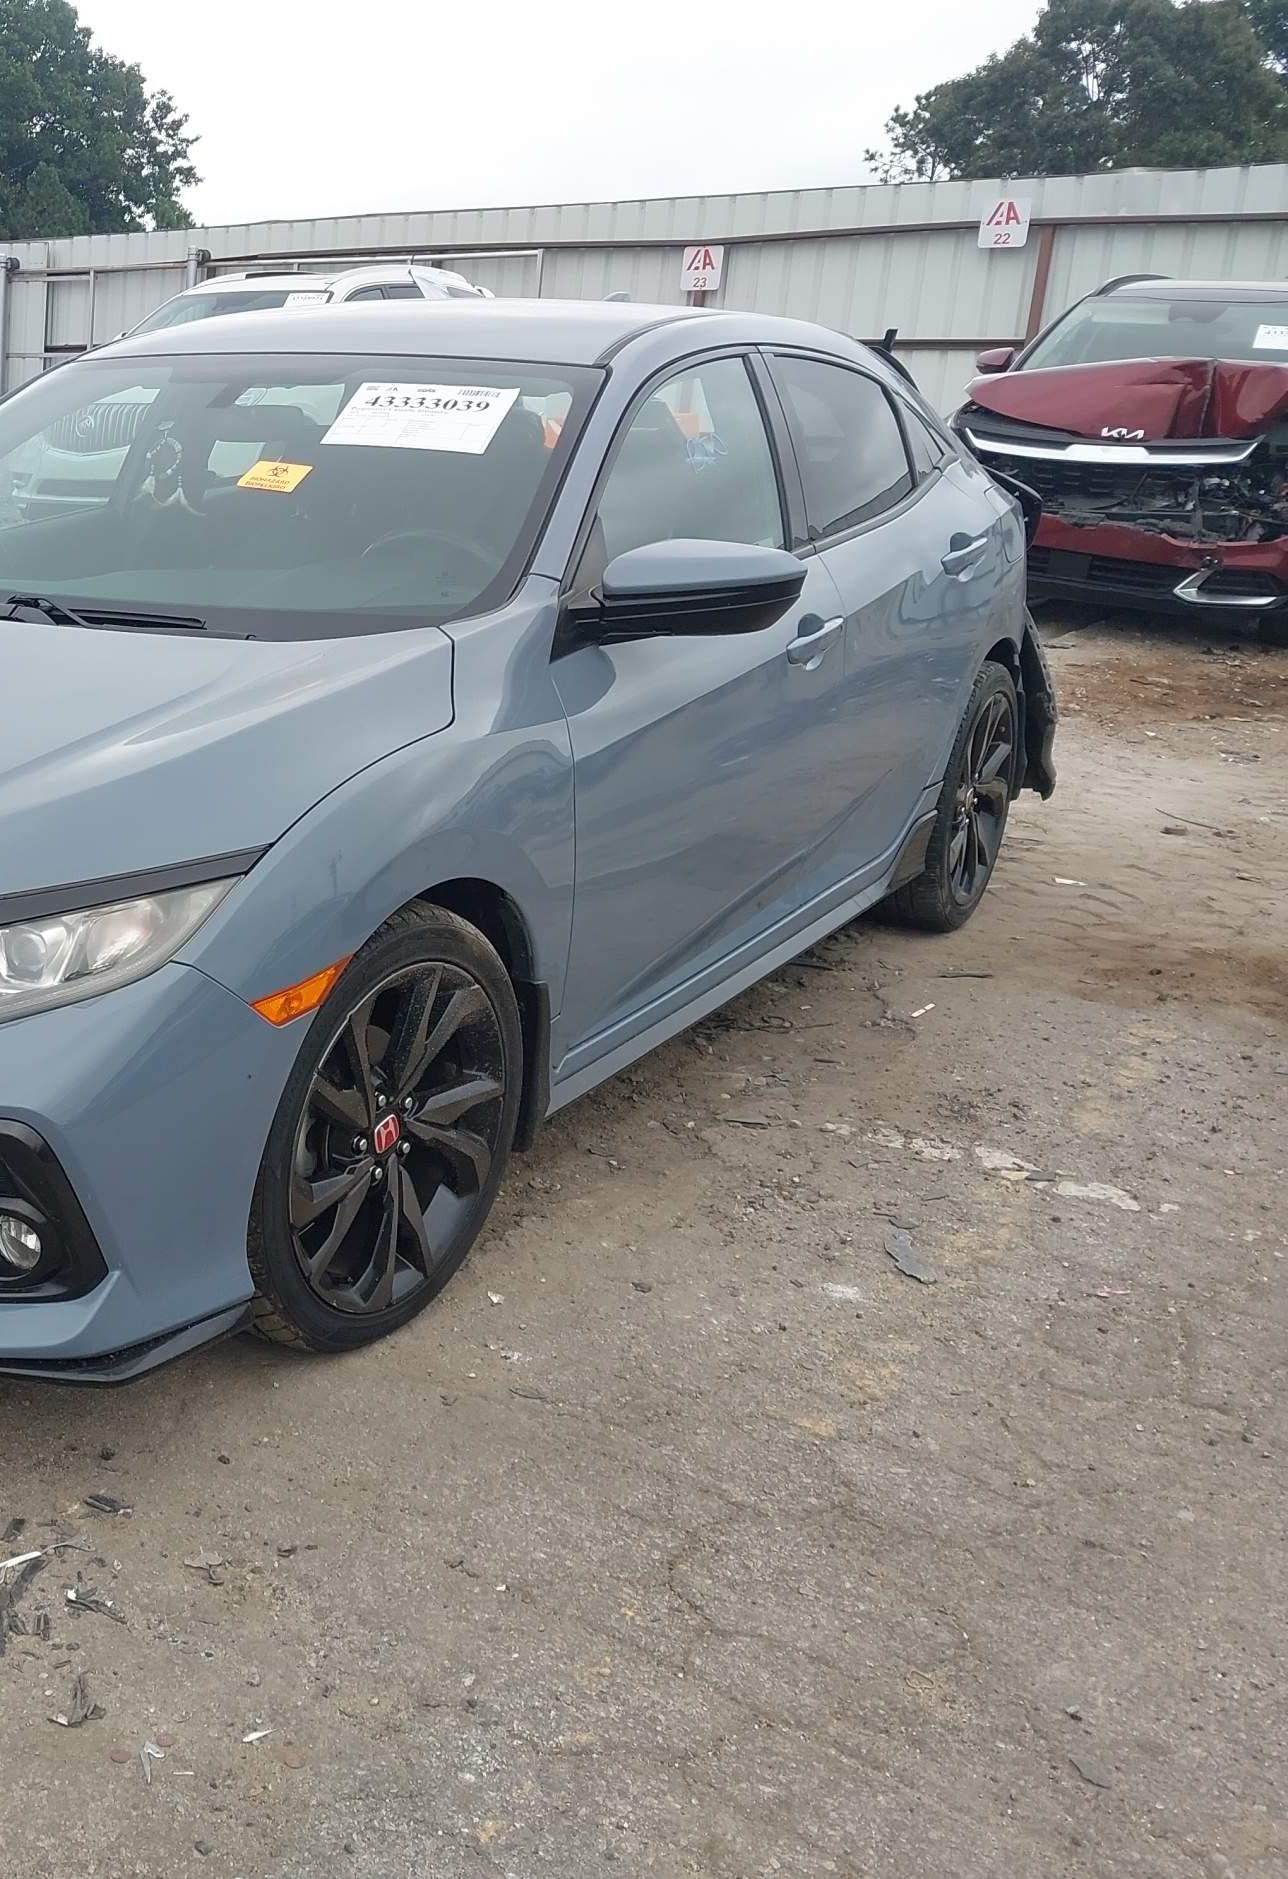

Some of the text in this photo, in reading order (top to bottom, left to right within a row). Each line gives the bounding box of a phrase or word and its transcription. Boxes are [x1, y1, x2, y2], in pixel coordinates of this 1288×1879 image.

[993, 233, 1011, 245] 22
[693, 277, 707, 288] 23
[364, 395, 491, 413] 43333039
